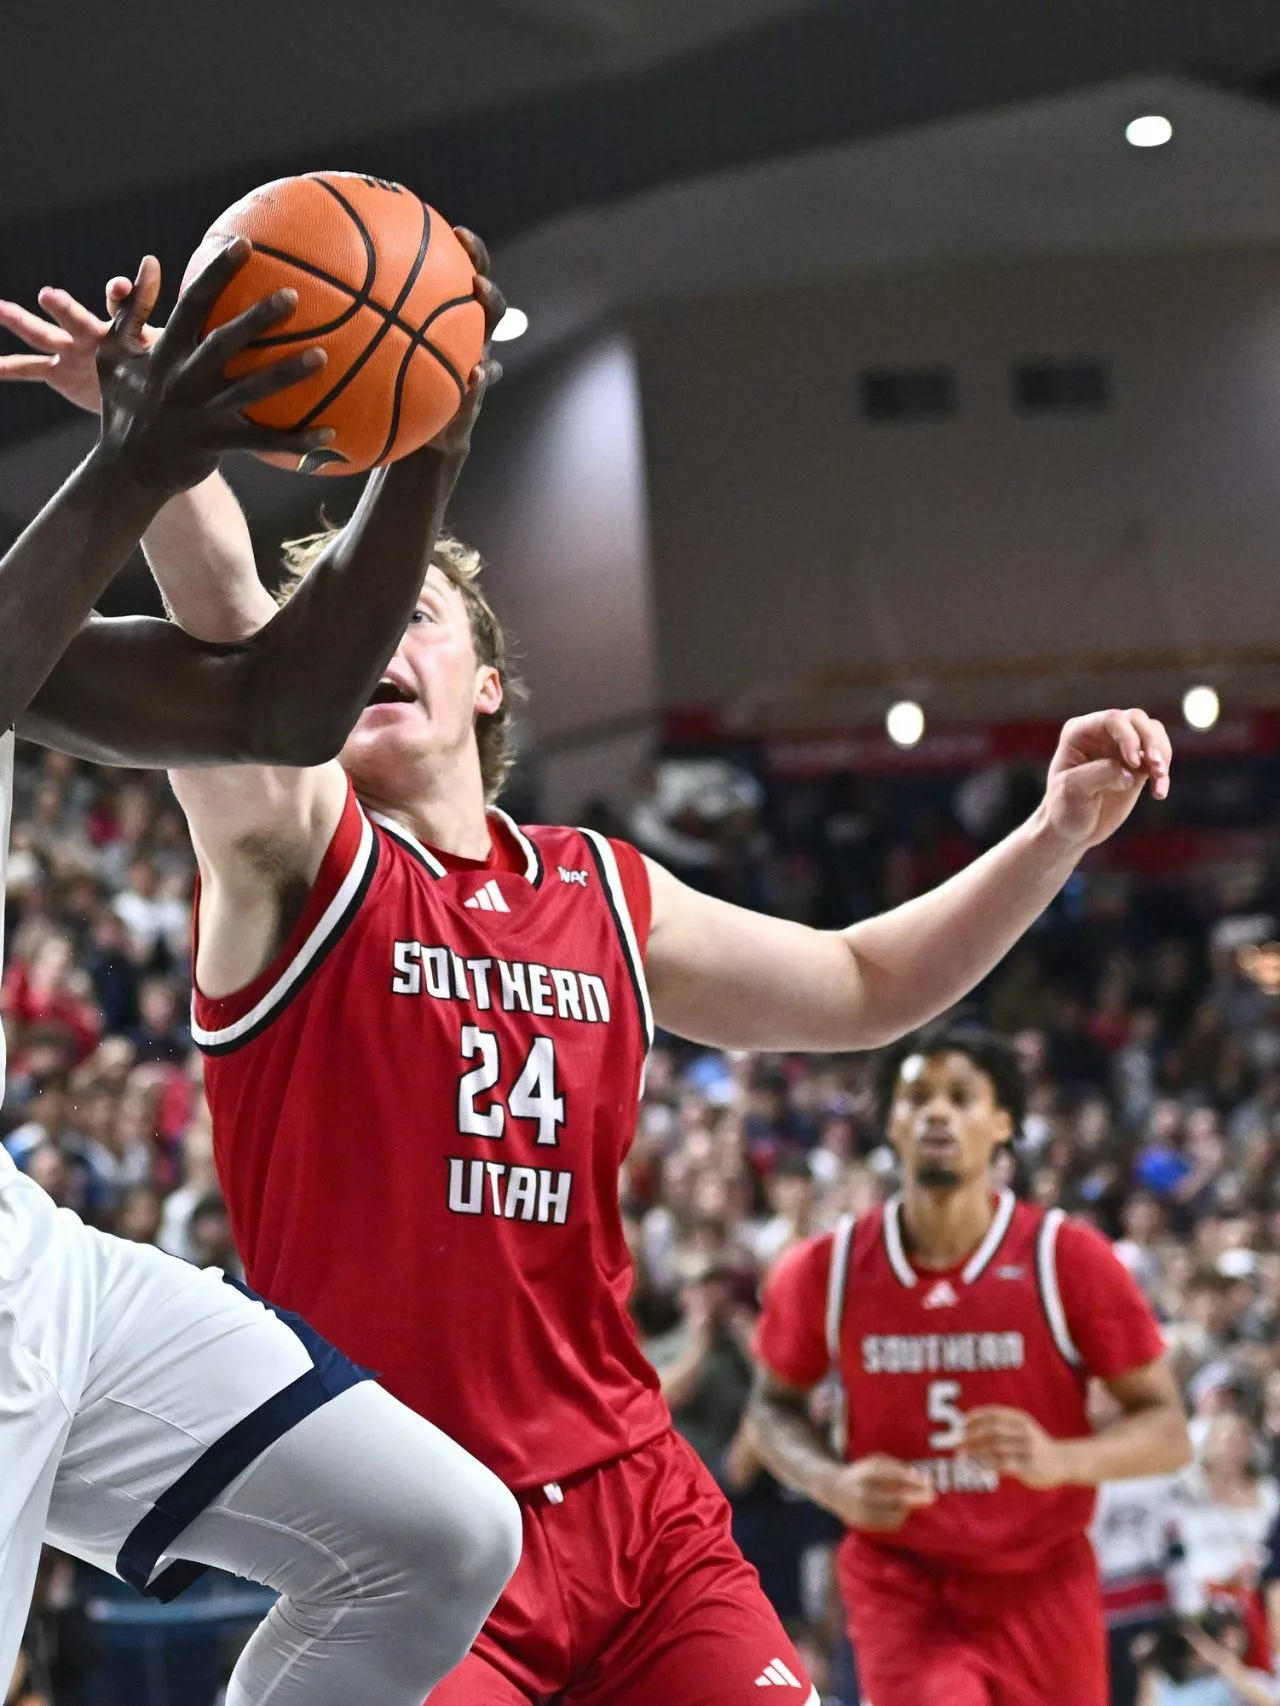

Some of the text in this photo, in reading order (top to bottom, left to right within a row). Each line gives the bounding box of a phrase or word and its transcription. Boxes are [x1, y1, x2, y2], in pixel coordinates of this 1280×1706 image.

[458, 1024, 566, 1146] 24
[446, 1156, 572, 1225] UTAH
[861, 1331, 1025, 1374] SOUTHERN
[926, 1379, 965, 1451] 5
